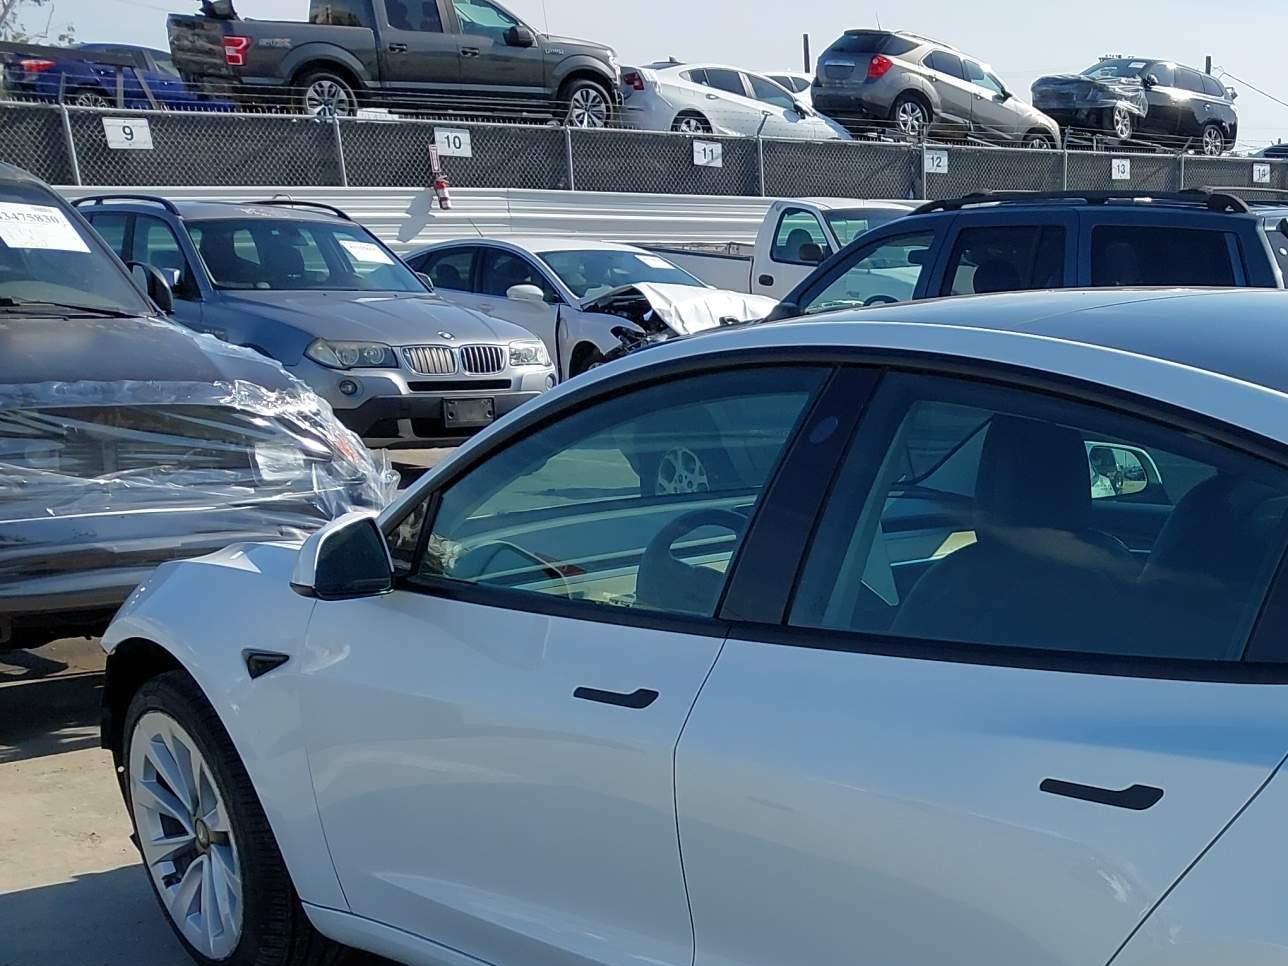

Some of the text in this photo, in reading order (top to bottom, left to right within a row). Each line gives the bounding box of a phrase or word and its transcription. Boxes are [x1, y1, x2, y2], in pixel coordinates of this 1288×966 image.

[122, 125, 134, 141] 9
[444, 135, 462, 149] 10
[701, 146, 714, 160] 11
[931, 156, 942, 168] 12
[1117, 164, 1126, 175] 13
[1258, 167, 1266, 178] 14
[0, 211, 60, 224] 3475830
